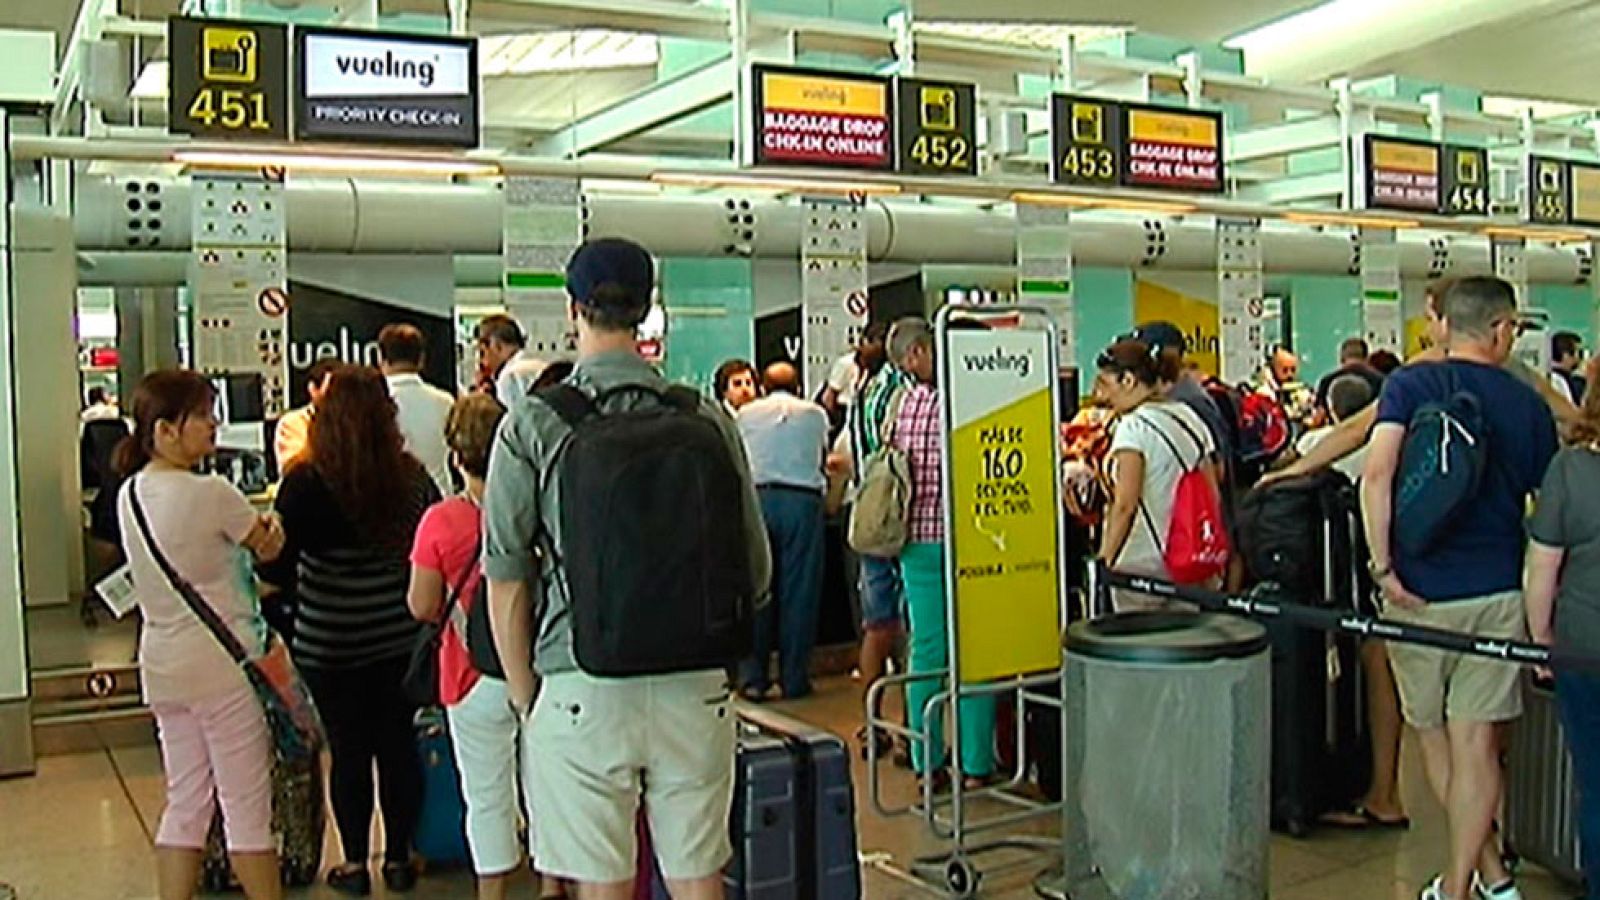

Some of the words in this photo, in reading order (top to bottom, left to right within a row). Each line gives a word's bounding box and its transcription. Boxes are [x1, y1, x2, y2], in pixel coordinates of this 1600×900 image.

[337, 50, 436, 88] vueling
[189, 88, 271, 130] 451
[765, 112, 840, 135] BAGGAGE
[843, 117, 885, 137] DROP
[825, 136, 884, 156] ONLINE
[912, 137, 968, 167] 452
[1063, 146, 1113, 178] 453
[1451, 186, 1485, 211] 454
[290, 327, 385, 368] uelin
[1182, 324, 1218, 353] elin
[964, 346, 1030, 378] vueling
[983, 447, 1023, 480] 160
